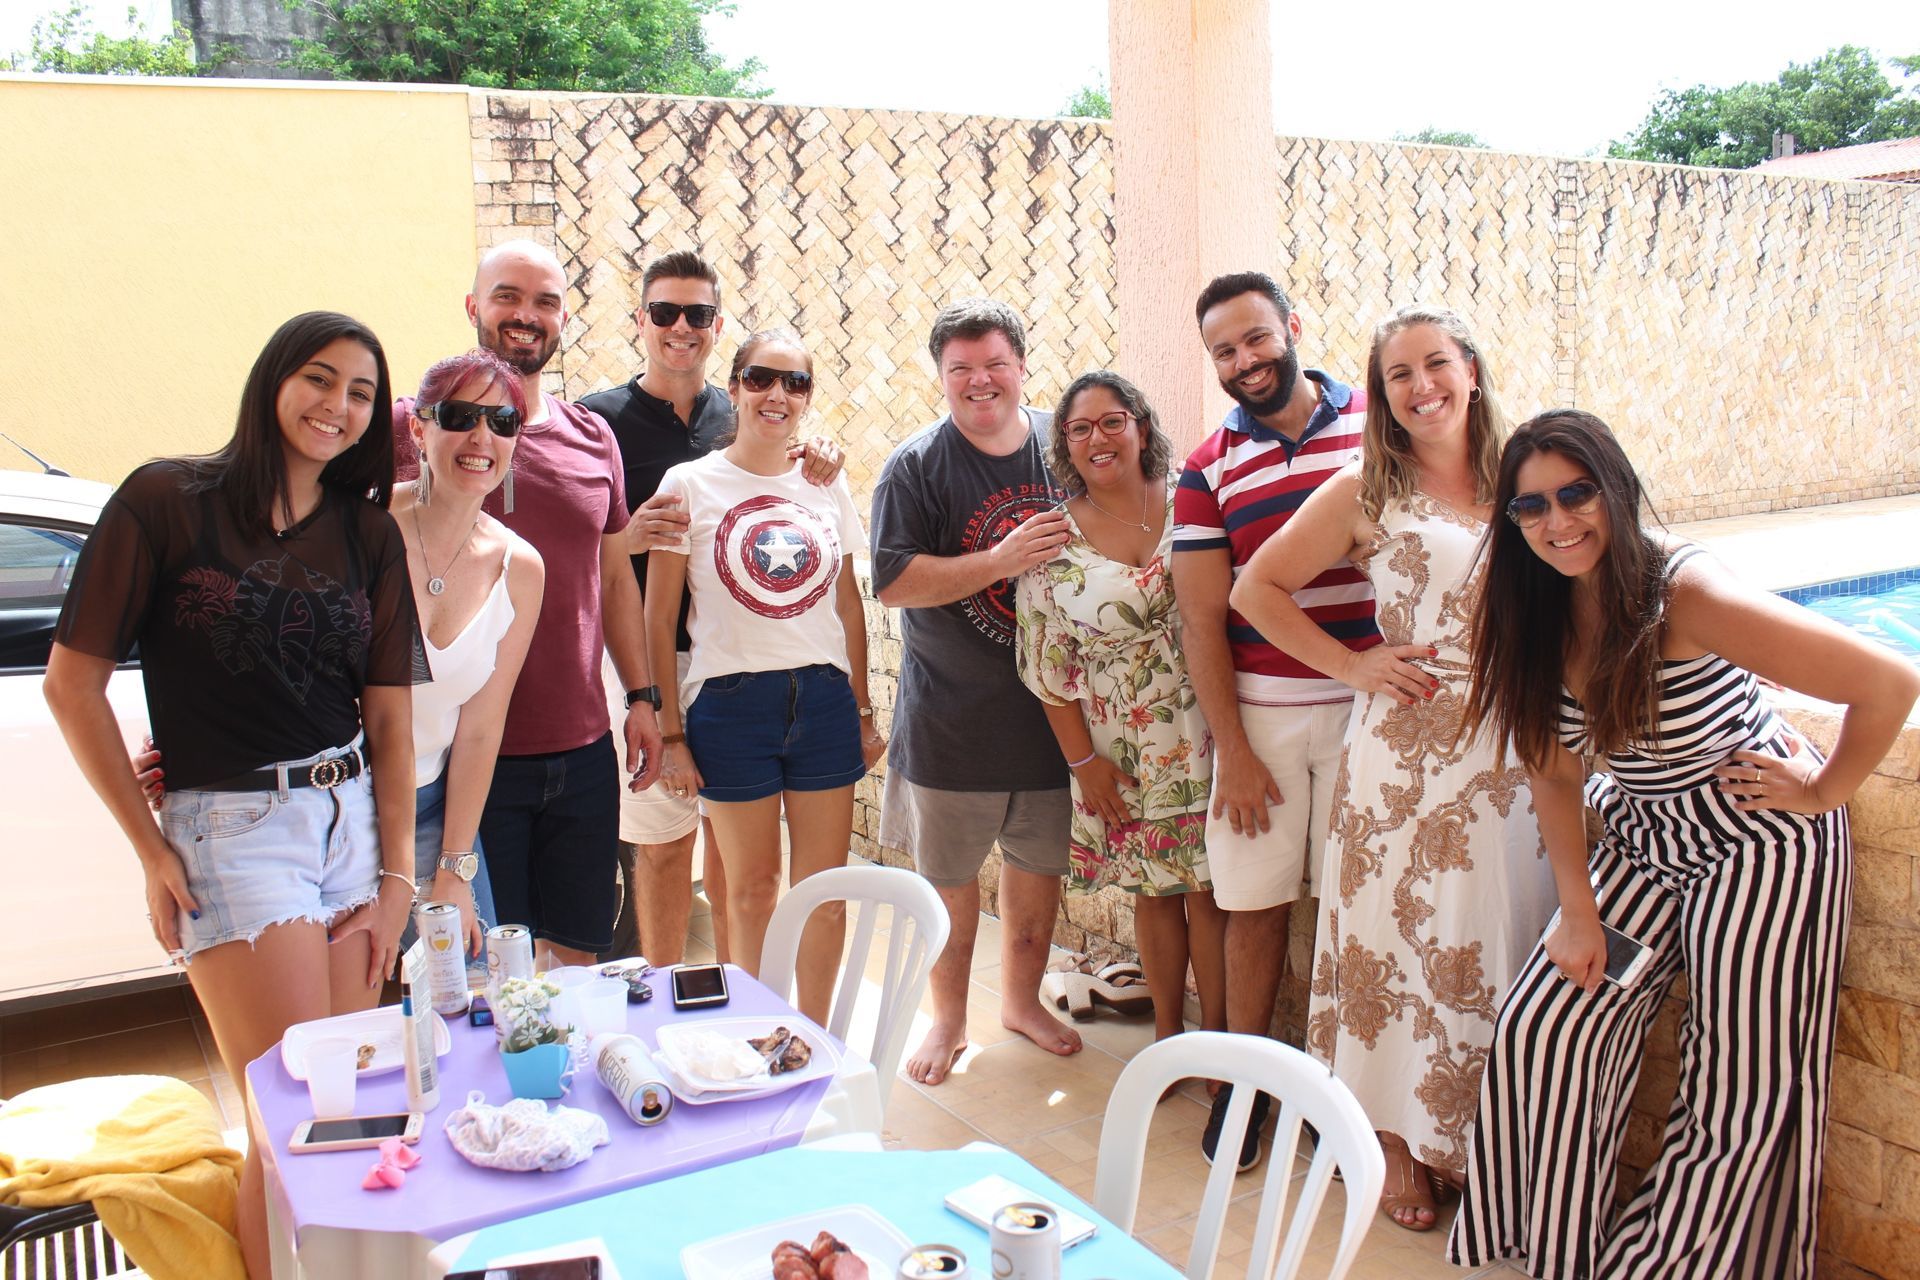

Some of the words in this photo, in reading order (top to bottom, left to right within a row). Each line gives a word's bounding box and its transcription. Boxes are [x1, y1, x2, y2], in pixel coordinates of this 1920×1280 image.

[983, 487, 1013, 509] SPAN
[1019, 483, 1070, 500] DECAD
[961, 598, 1013, 647] IFETIME
